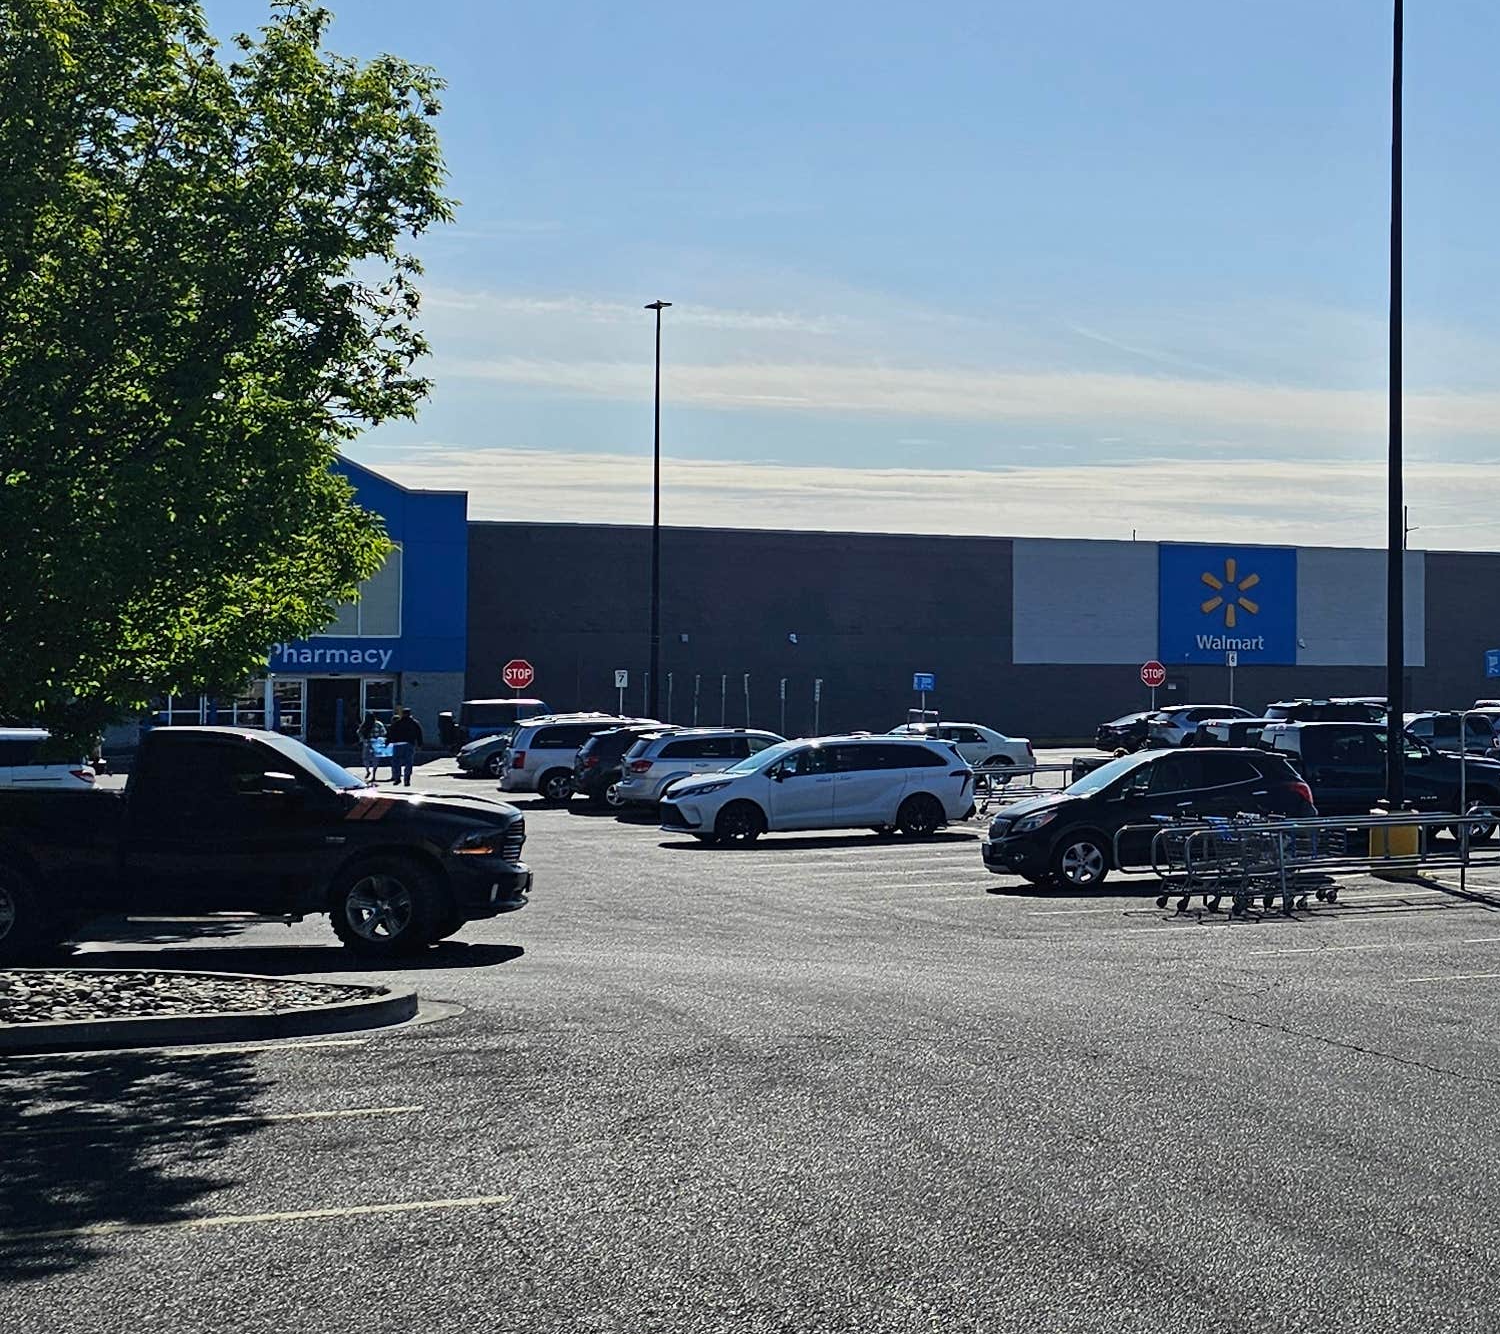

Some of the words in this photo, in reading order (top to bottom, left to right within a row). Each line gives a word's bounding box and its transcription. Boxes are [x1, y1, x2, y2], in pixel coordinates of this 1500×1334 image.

[1196, 634, 1264, 650] Walmart
[268, 642, 392, 669] Pharmacy
[505, 668, 532, 679] STOP
[1143, 669, 1163, 678] STOP
